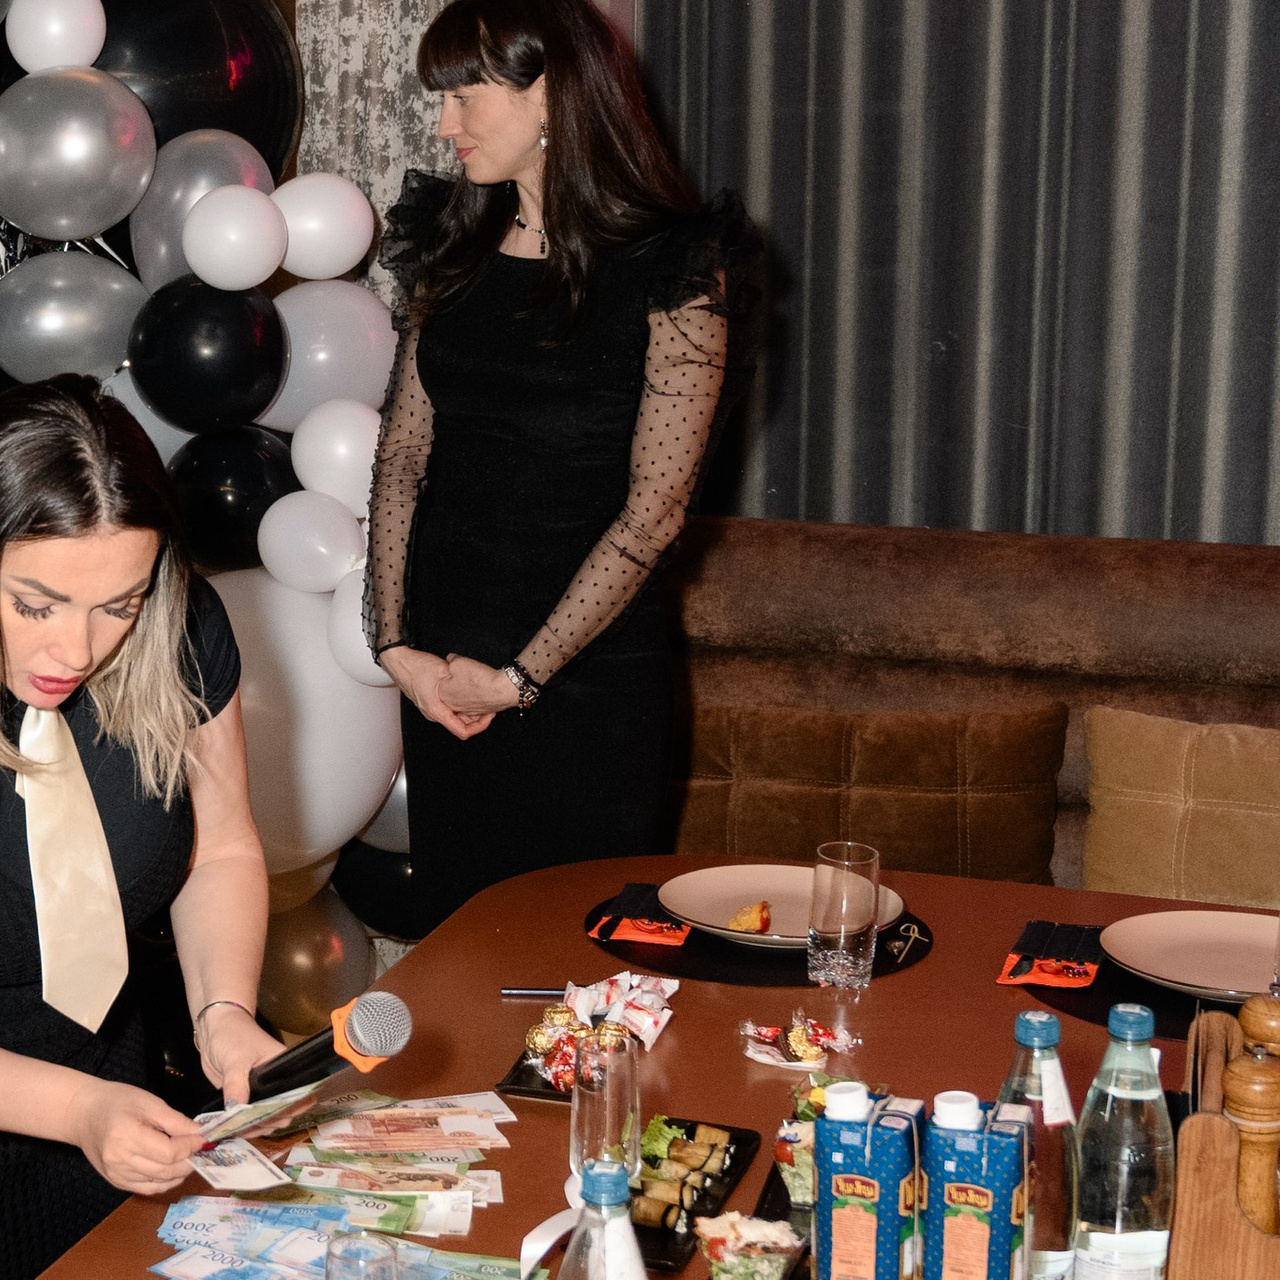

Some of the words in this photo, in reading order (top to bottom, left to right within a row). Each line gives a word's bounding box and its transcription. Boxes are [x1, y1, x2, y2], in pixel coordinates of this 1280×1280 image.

[355, 1198, 387, 1211] 200
[172, 1221, 217, 1234] 2000
[200, 1249, 245, 1268] 2000
[481, 1264, 507, 1276] 200
